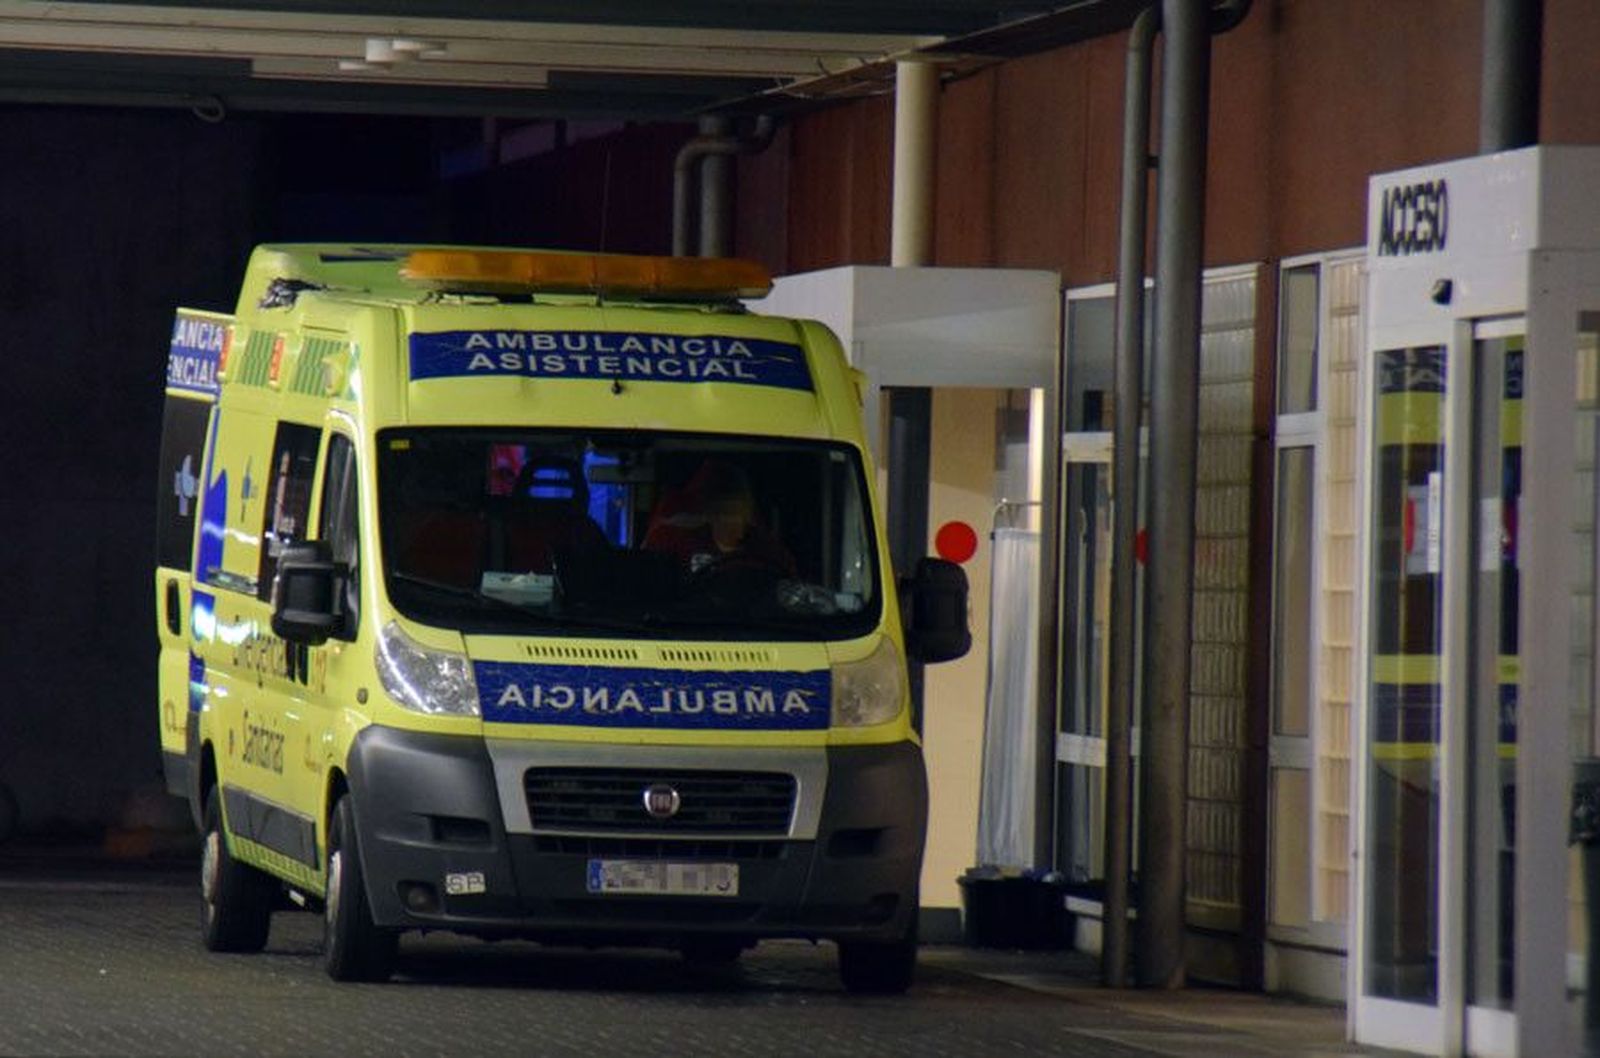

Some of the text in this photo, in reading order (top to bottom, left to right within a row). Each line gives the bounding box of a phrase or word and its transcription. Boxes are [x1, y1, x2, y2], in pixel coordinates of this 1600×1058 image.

[1378, 178, 1449, 257] ACCESO
[465, 332, 753, 358] AMBULANCIA
[467, 353, 757, 380] ASISTENCIAL
